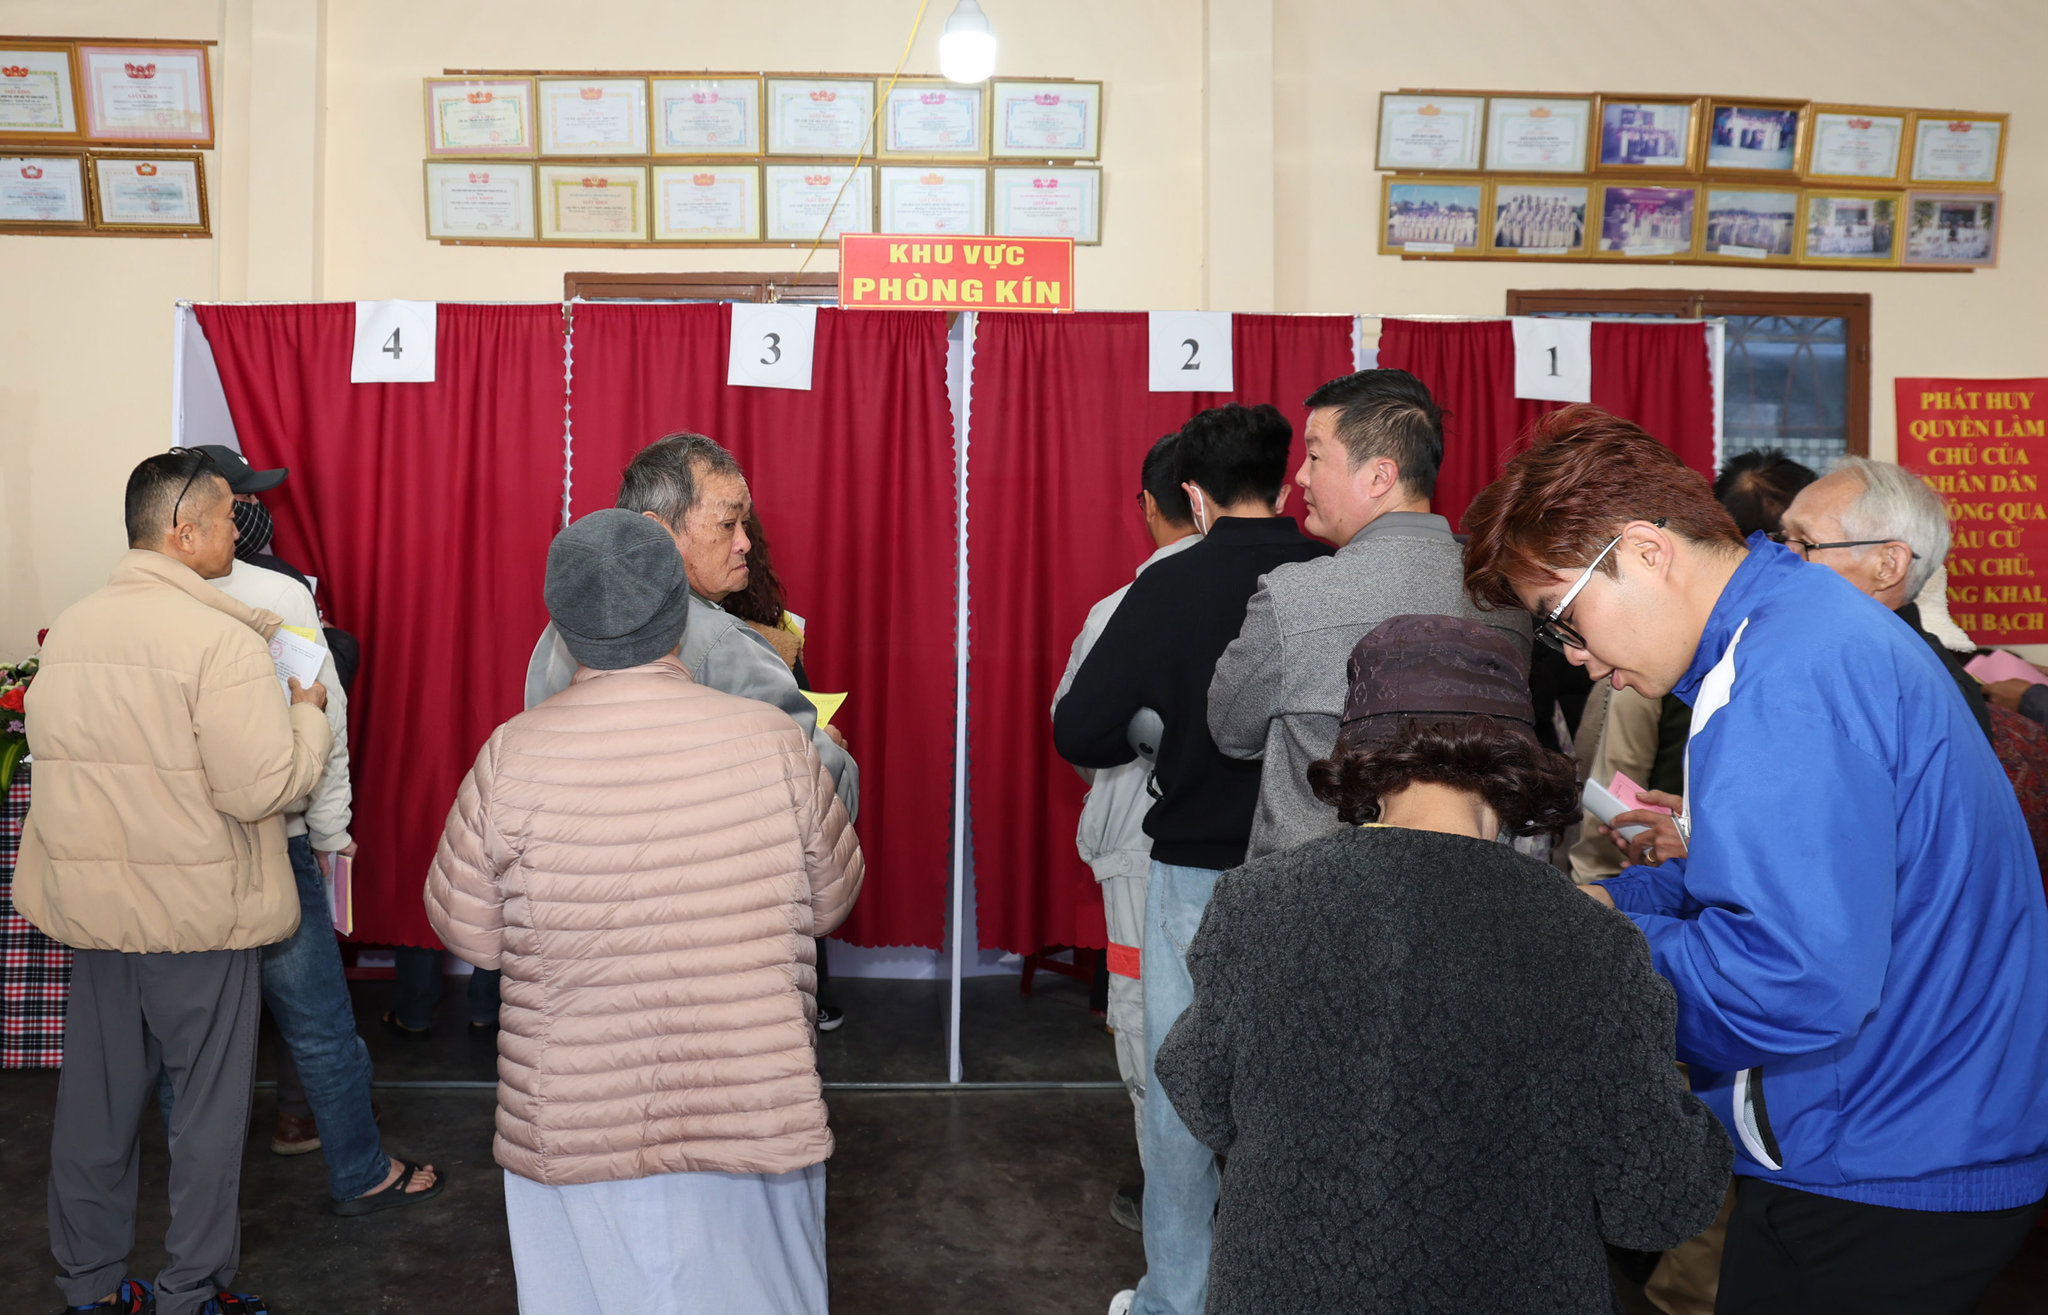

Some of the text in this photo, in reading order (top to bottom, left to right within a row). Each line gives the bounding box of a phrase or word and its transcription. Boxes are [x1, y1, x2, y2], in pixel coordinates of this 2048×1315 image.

[889, 243, 1025, 269] KHU VỰC
[852, 273, 1061, 305] PHÒNG KÍN
[382, 327, 403, 360] 4
[760, 332, 782, 365] 3
[1180, 338, 1201, 371] 2
[1545, 345, 1562, 377] 1
[1921, 387, 2035, 410] PHÁT HUY
[1909, 414, 2046, 442] QUYỀN LÀM
[1928, 441, 2030, 466] CHỦ CỦA
[1991, 469, 2038, 493] DÂN
[1945, 497, 2046, 524] ÔNG QUA
[1949, 525, 2025, 549] ẦU CỬ
[1946, 553, 1976, 577] ÂN
[1981, 613, 2045, 635] BẠCH
